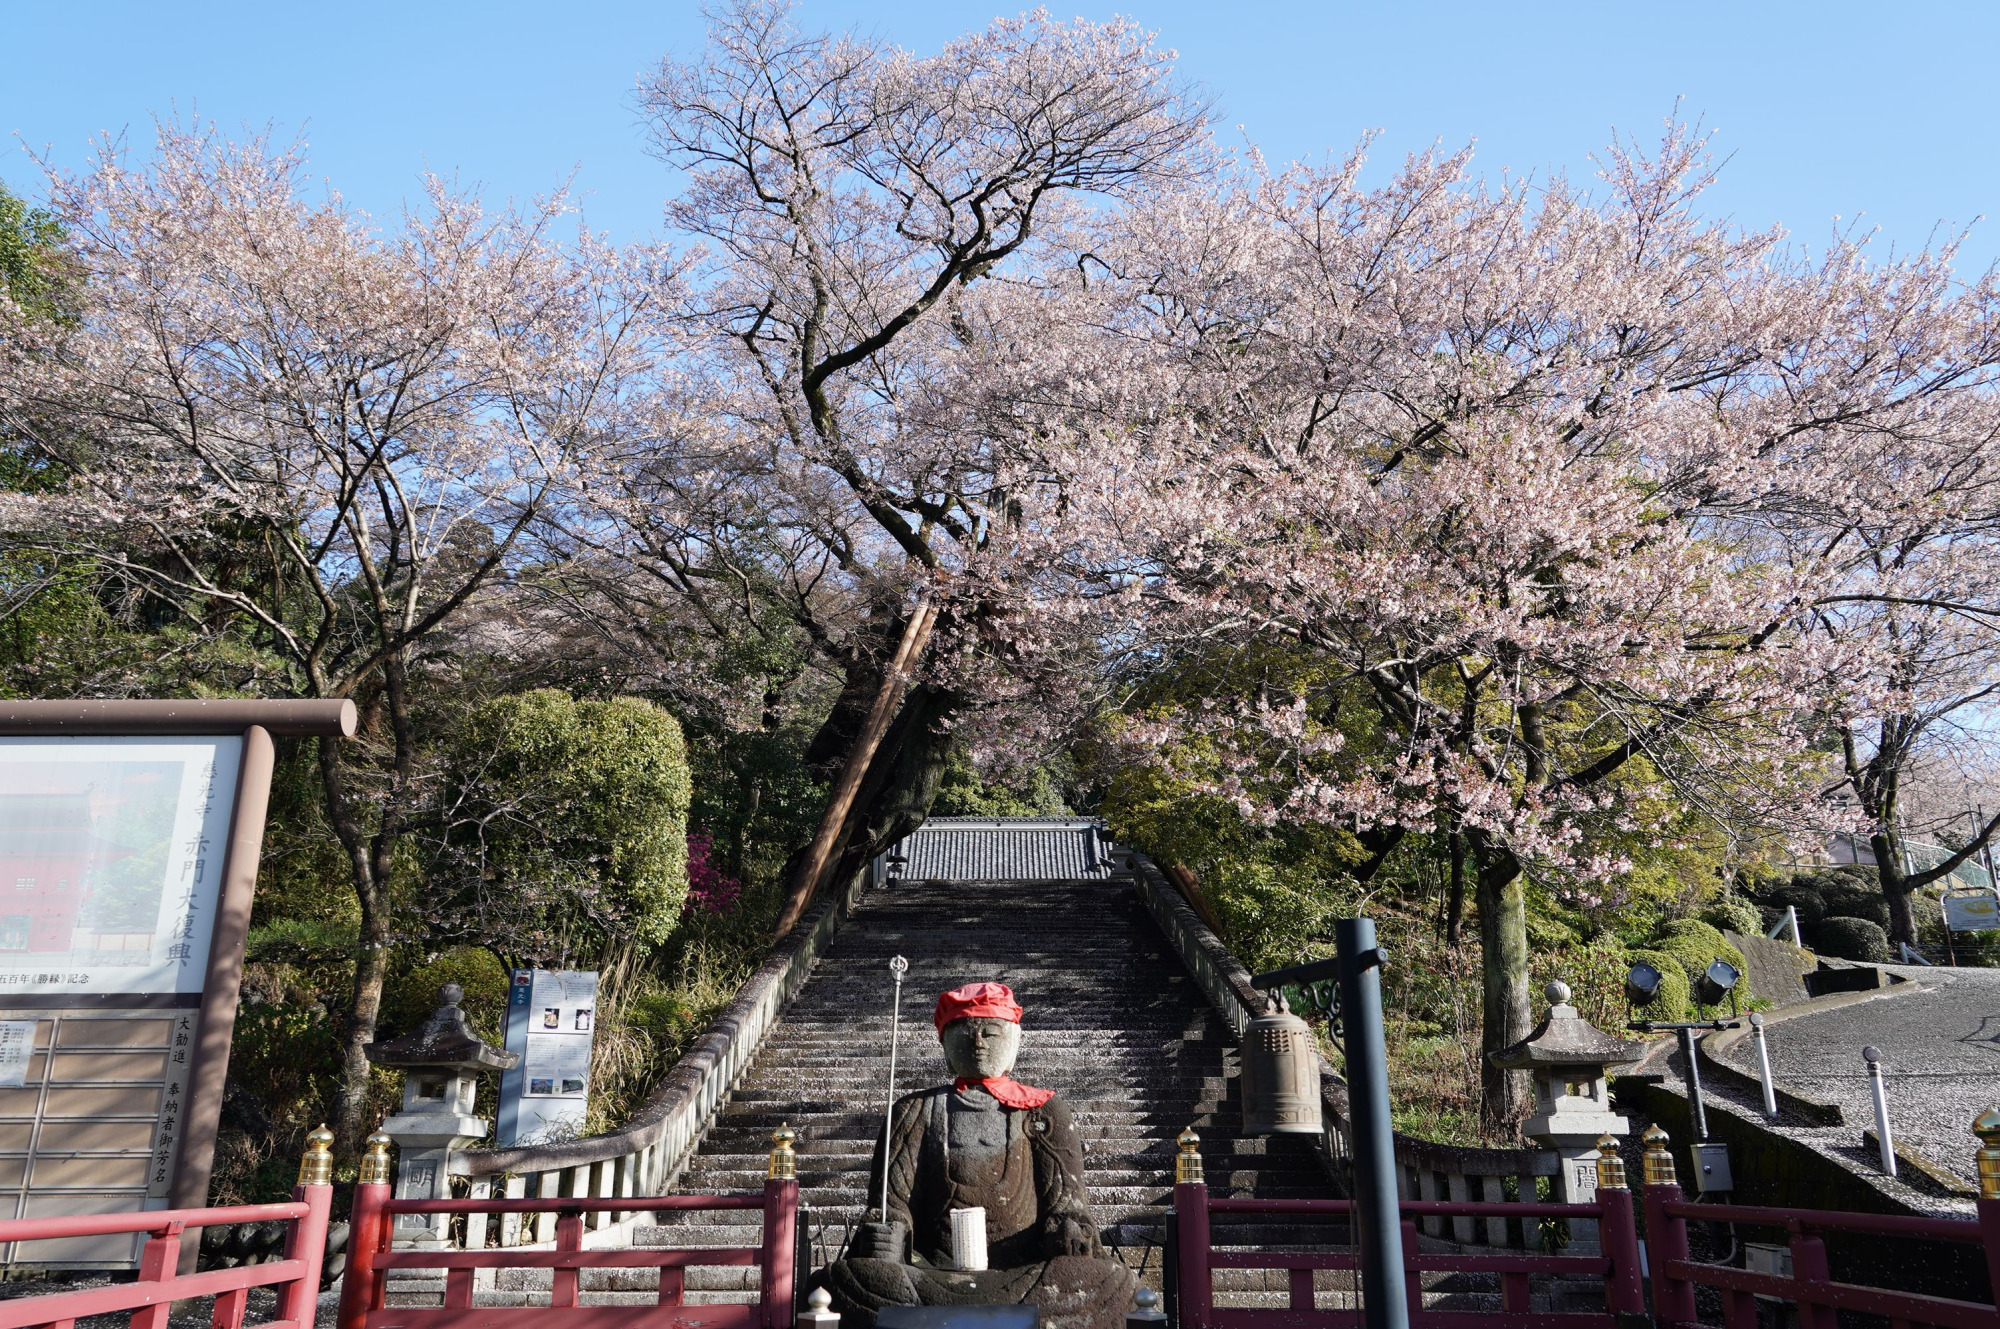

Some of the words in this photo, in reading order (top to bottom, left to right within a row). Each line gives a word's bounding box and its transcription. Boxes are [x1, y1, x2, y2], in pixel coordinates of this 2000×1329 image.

[165, 831, 211, 968] 赤門大復興
[152, 1081, 181, 1183] 奉納者御芳名
